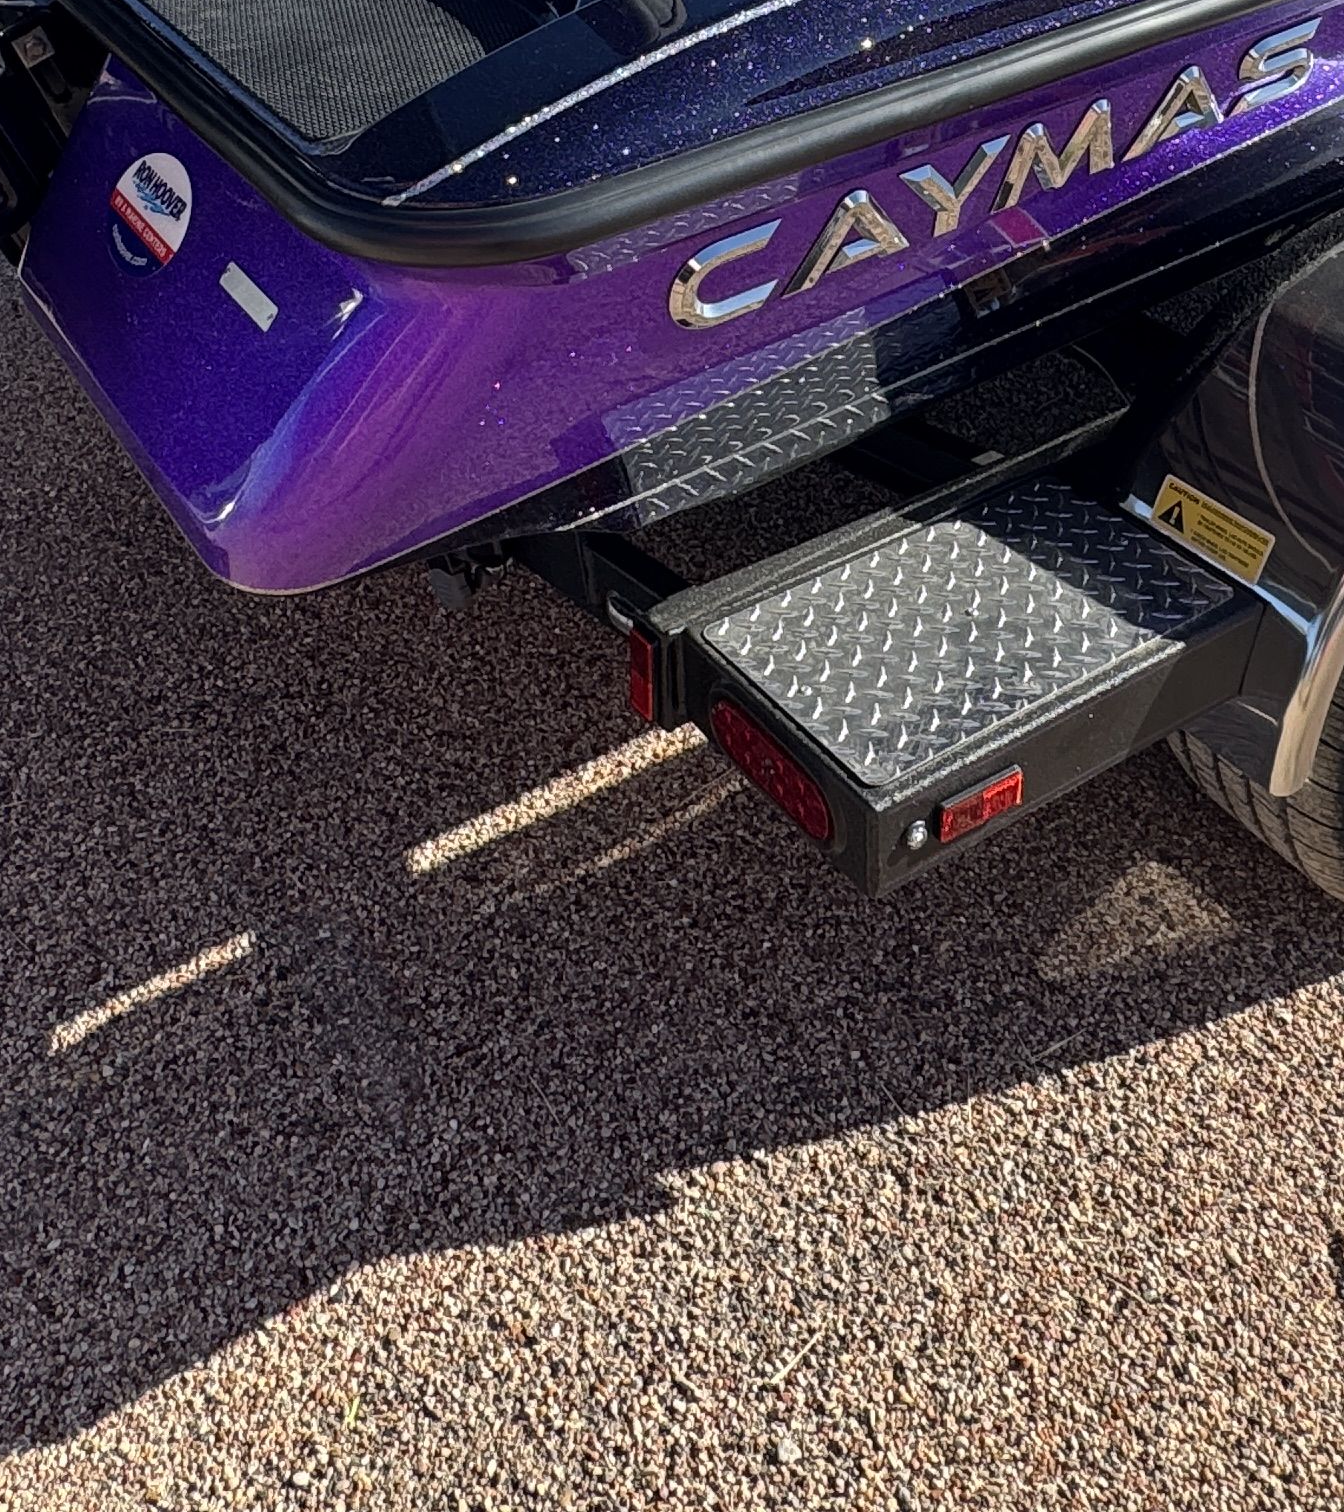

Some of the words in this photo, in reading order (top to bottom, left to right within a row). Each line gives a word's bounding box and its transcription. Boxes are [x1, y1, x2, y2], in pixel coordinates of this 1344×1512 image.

[132, 159, 157, 189] RON
[149, 175, 188, 222] HOOVER
[668, 16, 1323, 330] CAYMAS
[1168, 482, 1200, 505] CAUTION
